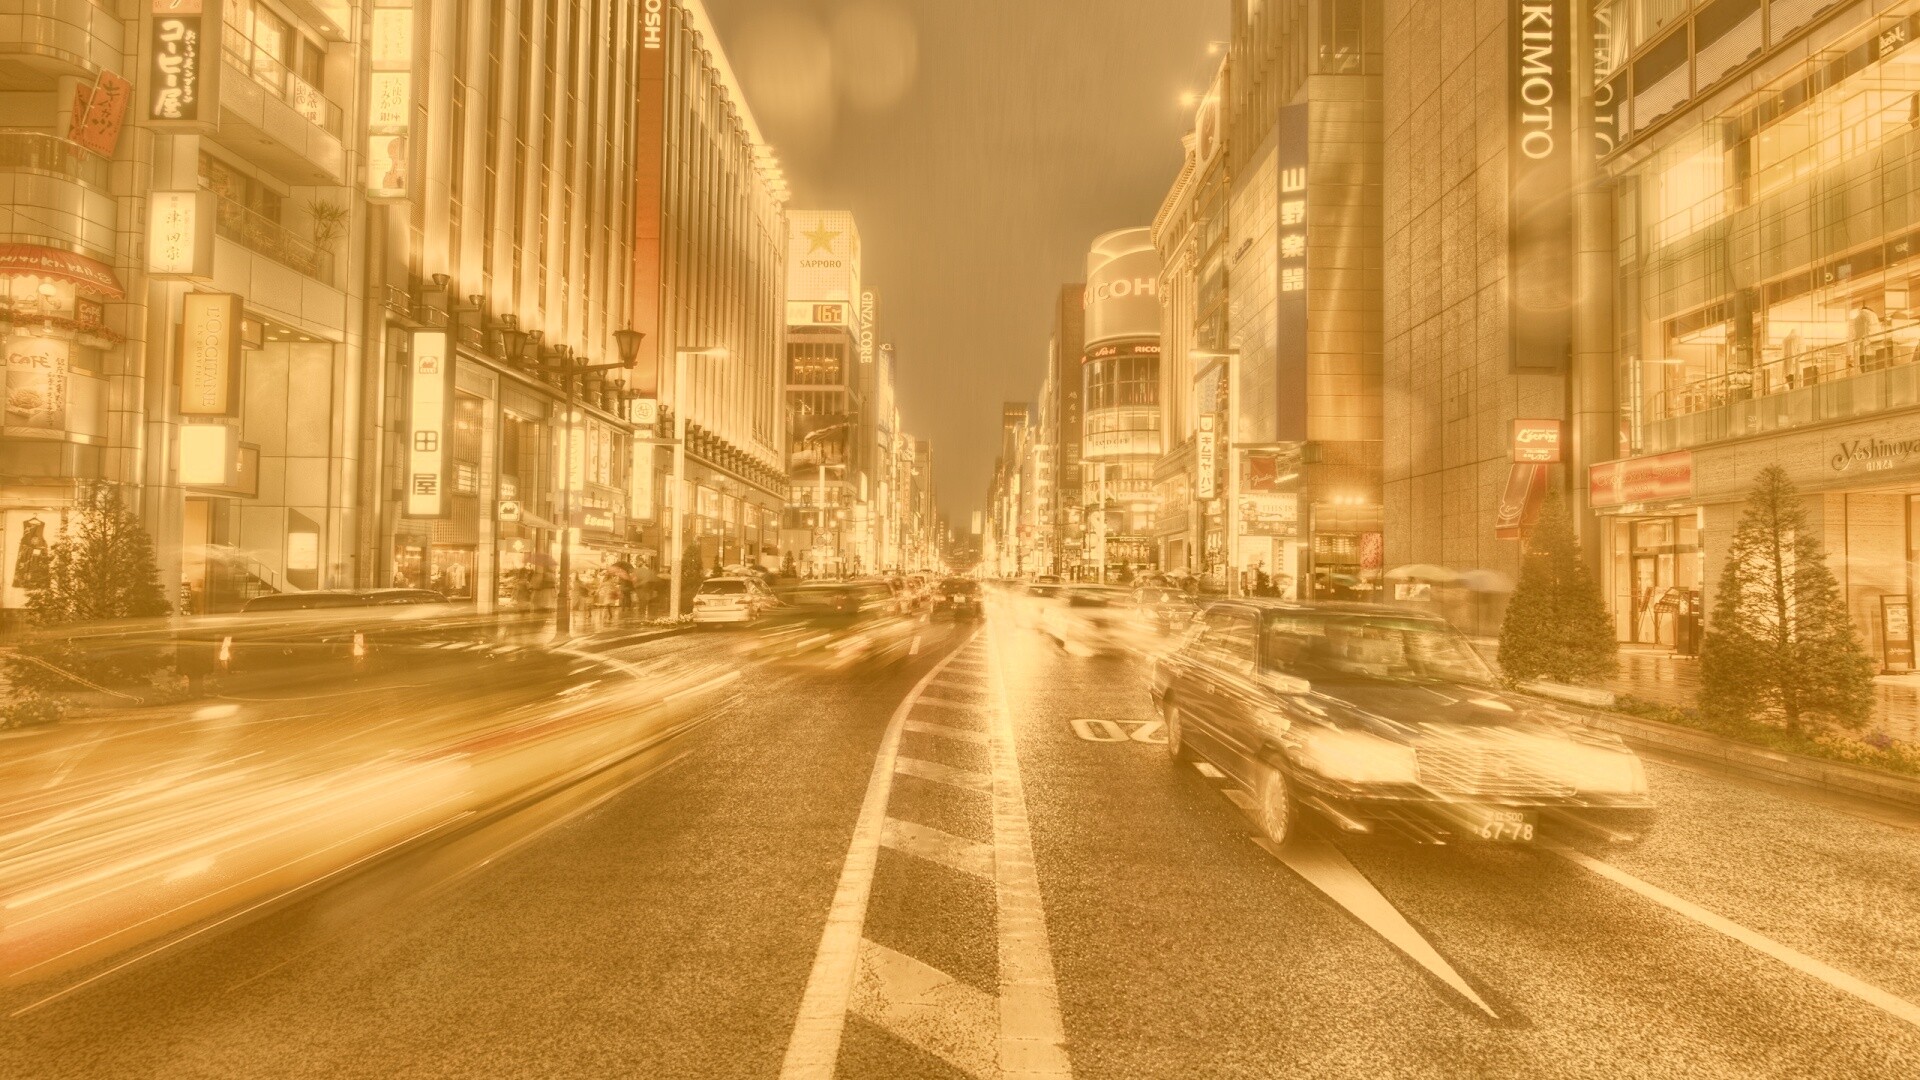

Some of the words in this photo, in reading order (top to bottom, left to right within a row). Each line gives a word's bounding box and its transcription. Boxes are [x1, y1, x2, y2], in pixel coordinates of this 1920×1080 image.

[154, 20, 185, 117] コーヒー屋
[1282, 167, 1305, 292] 山野楽器
[800, 259, 842, 269] SAPPORO
[860, 291, 874, 329] GINZA
[1083, 277, 1156, 310] RICOH
[203, 306, 222, 407] L'OCCITANE
[860, 331, 873, 364] CORE
[1867, 459, 1893, 472] GINZA
[1481, 822, 1533, 841] 67-78
